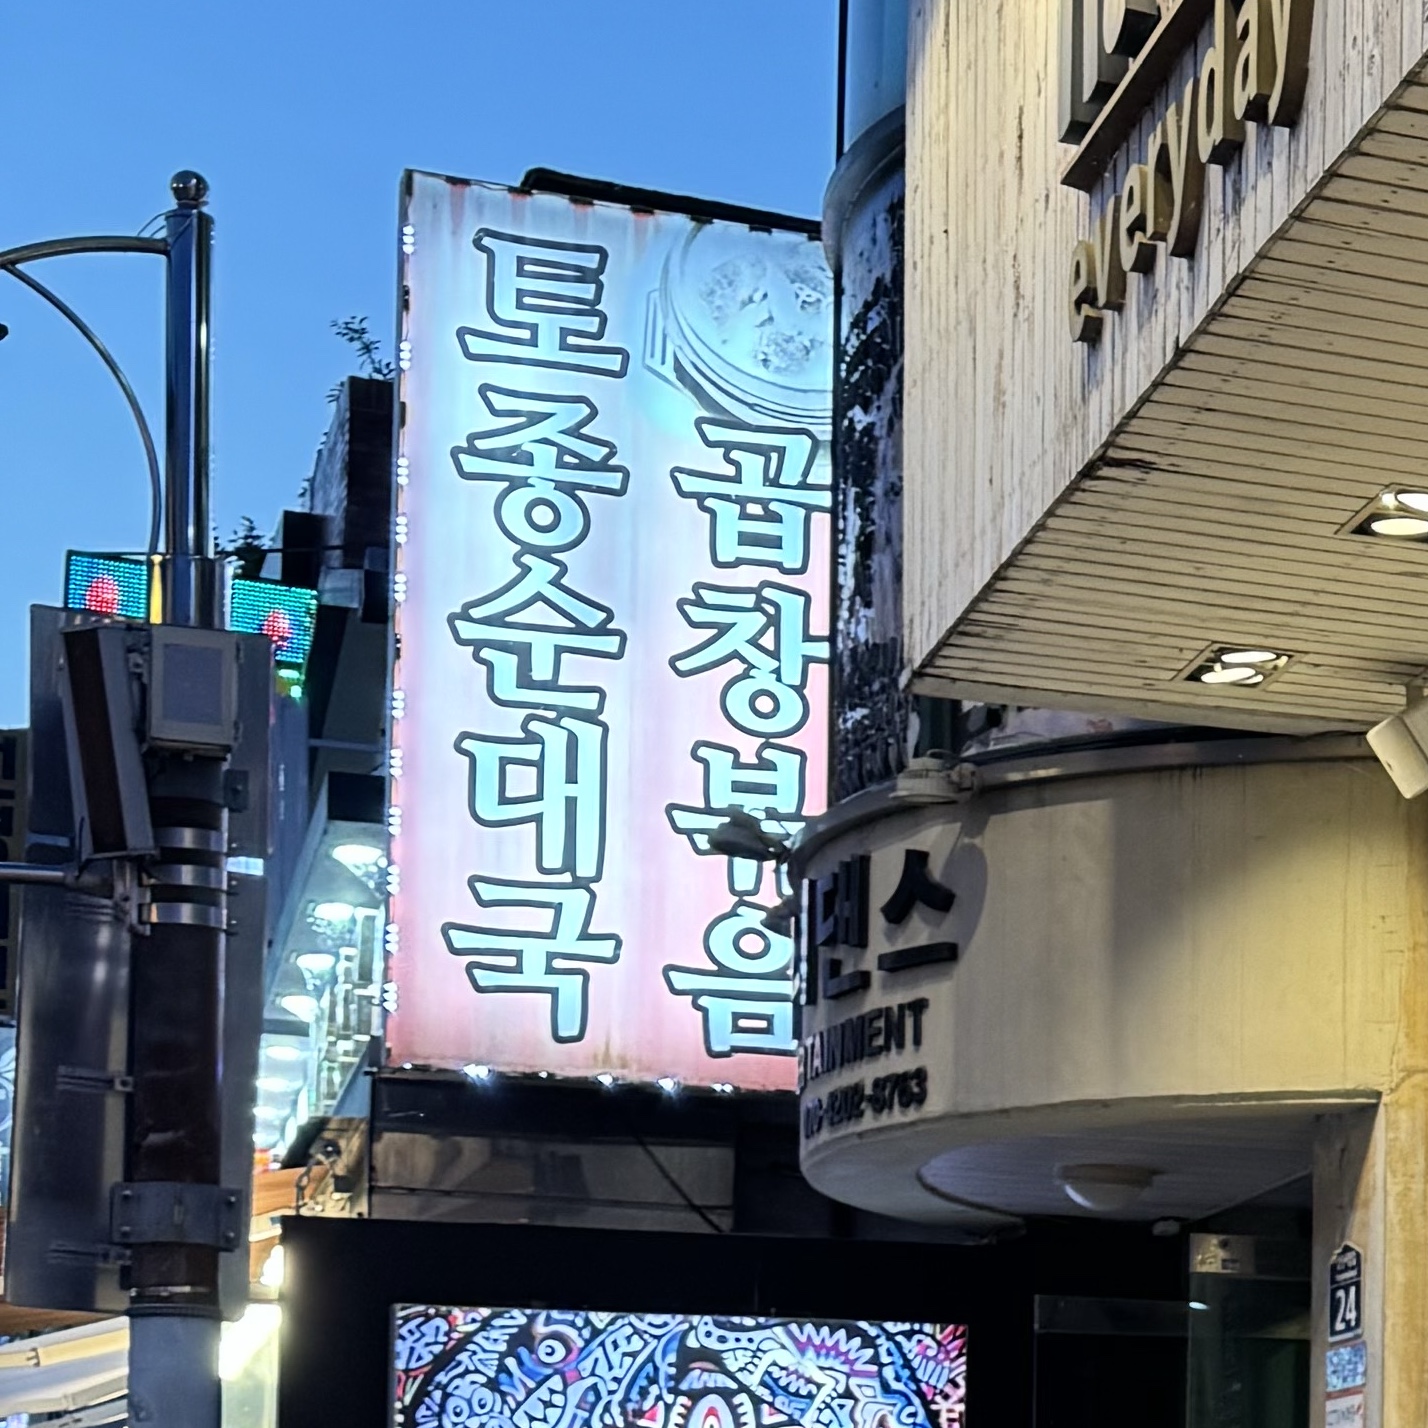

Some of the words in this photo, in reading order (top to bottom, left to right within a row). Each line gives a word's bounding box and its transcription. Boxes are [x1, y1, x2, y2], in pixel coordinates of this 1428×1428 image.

[1069, 0, 1314, 342] everyday
[441, 227, 630, 1042] 토종순대국
[801, 849, 959, 1005] 댄스
[1334, 1285, 1357, 1331] 24
